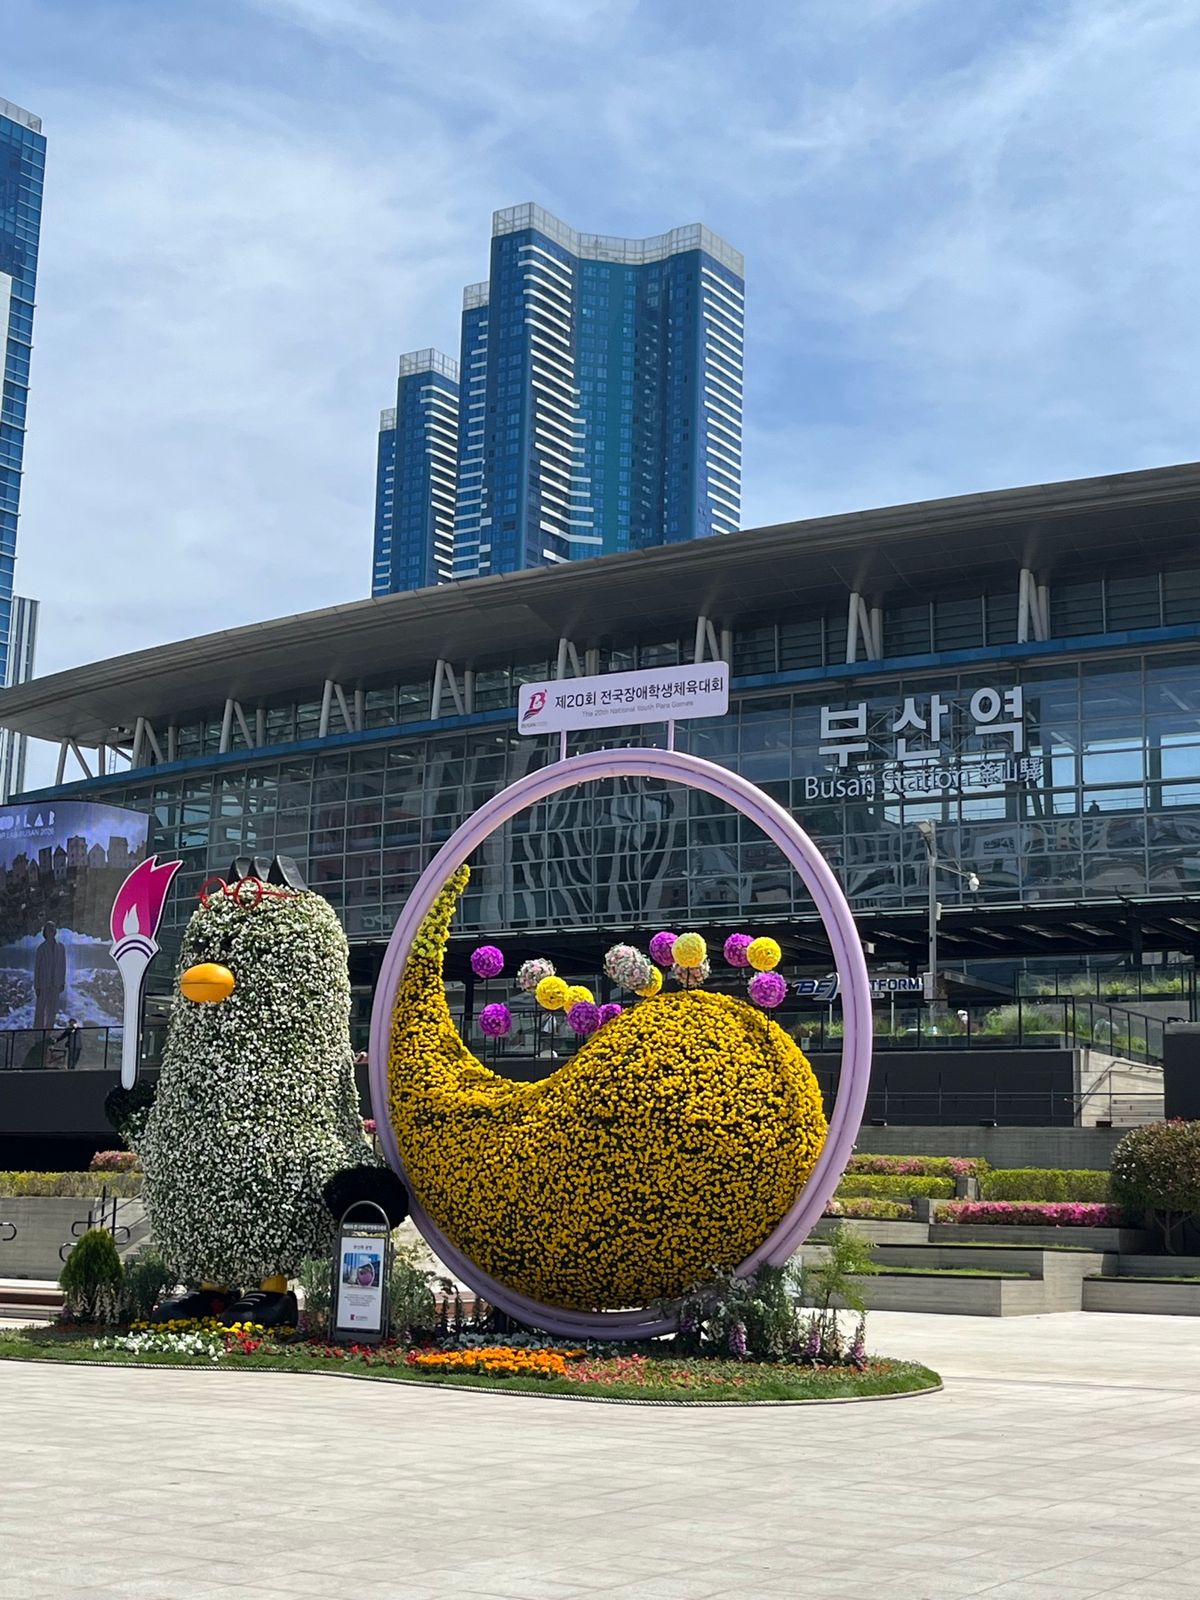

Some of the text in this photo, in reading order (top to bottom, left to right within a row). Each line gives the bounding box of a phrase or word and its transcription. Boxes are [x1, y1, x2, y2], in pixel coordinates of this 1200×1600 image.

[555, 677, 724, 709] 제20회 전국장애학생체육대회
[610, 706, 636, 714] National
[818, 686, 1023, 768] 부산역
[804, 776, 876, 800] Busan
[881, 766, 970, 794] Station
[868, 978, 921, 990] TFORM
